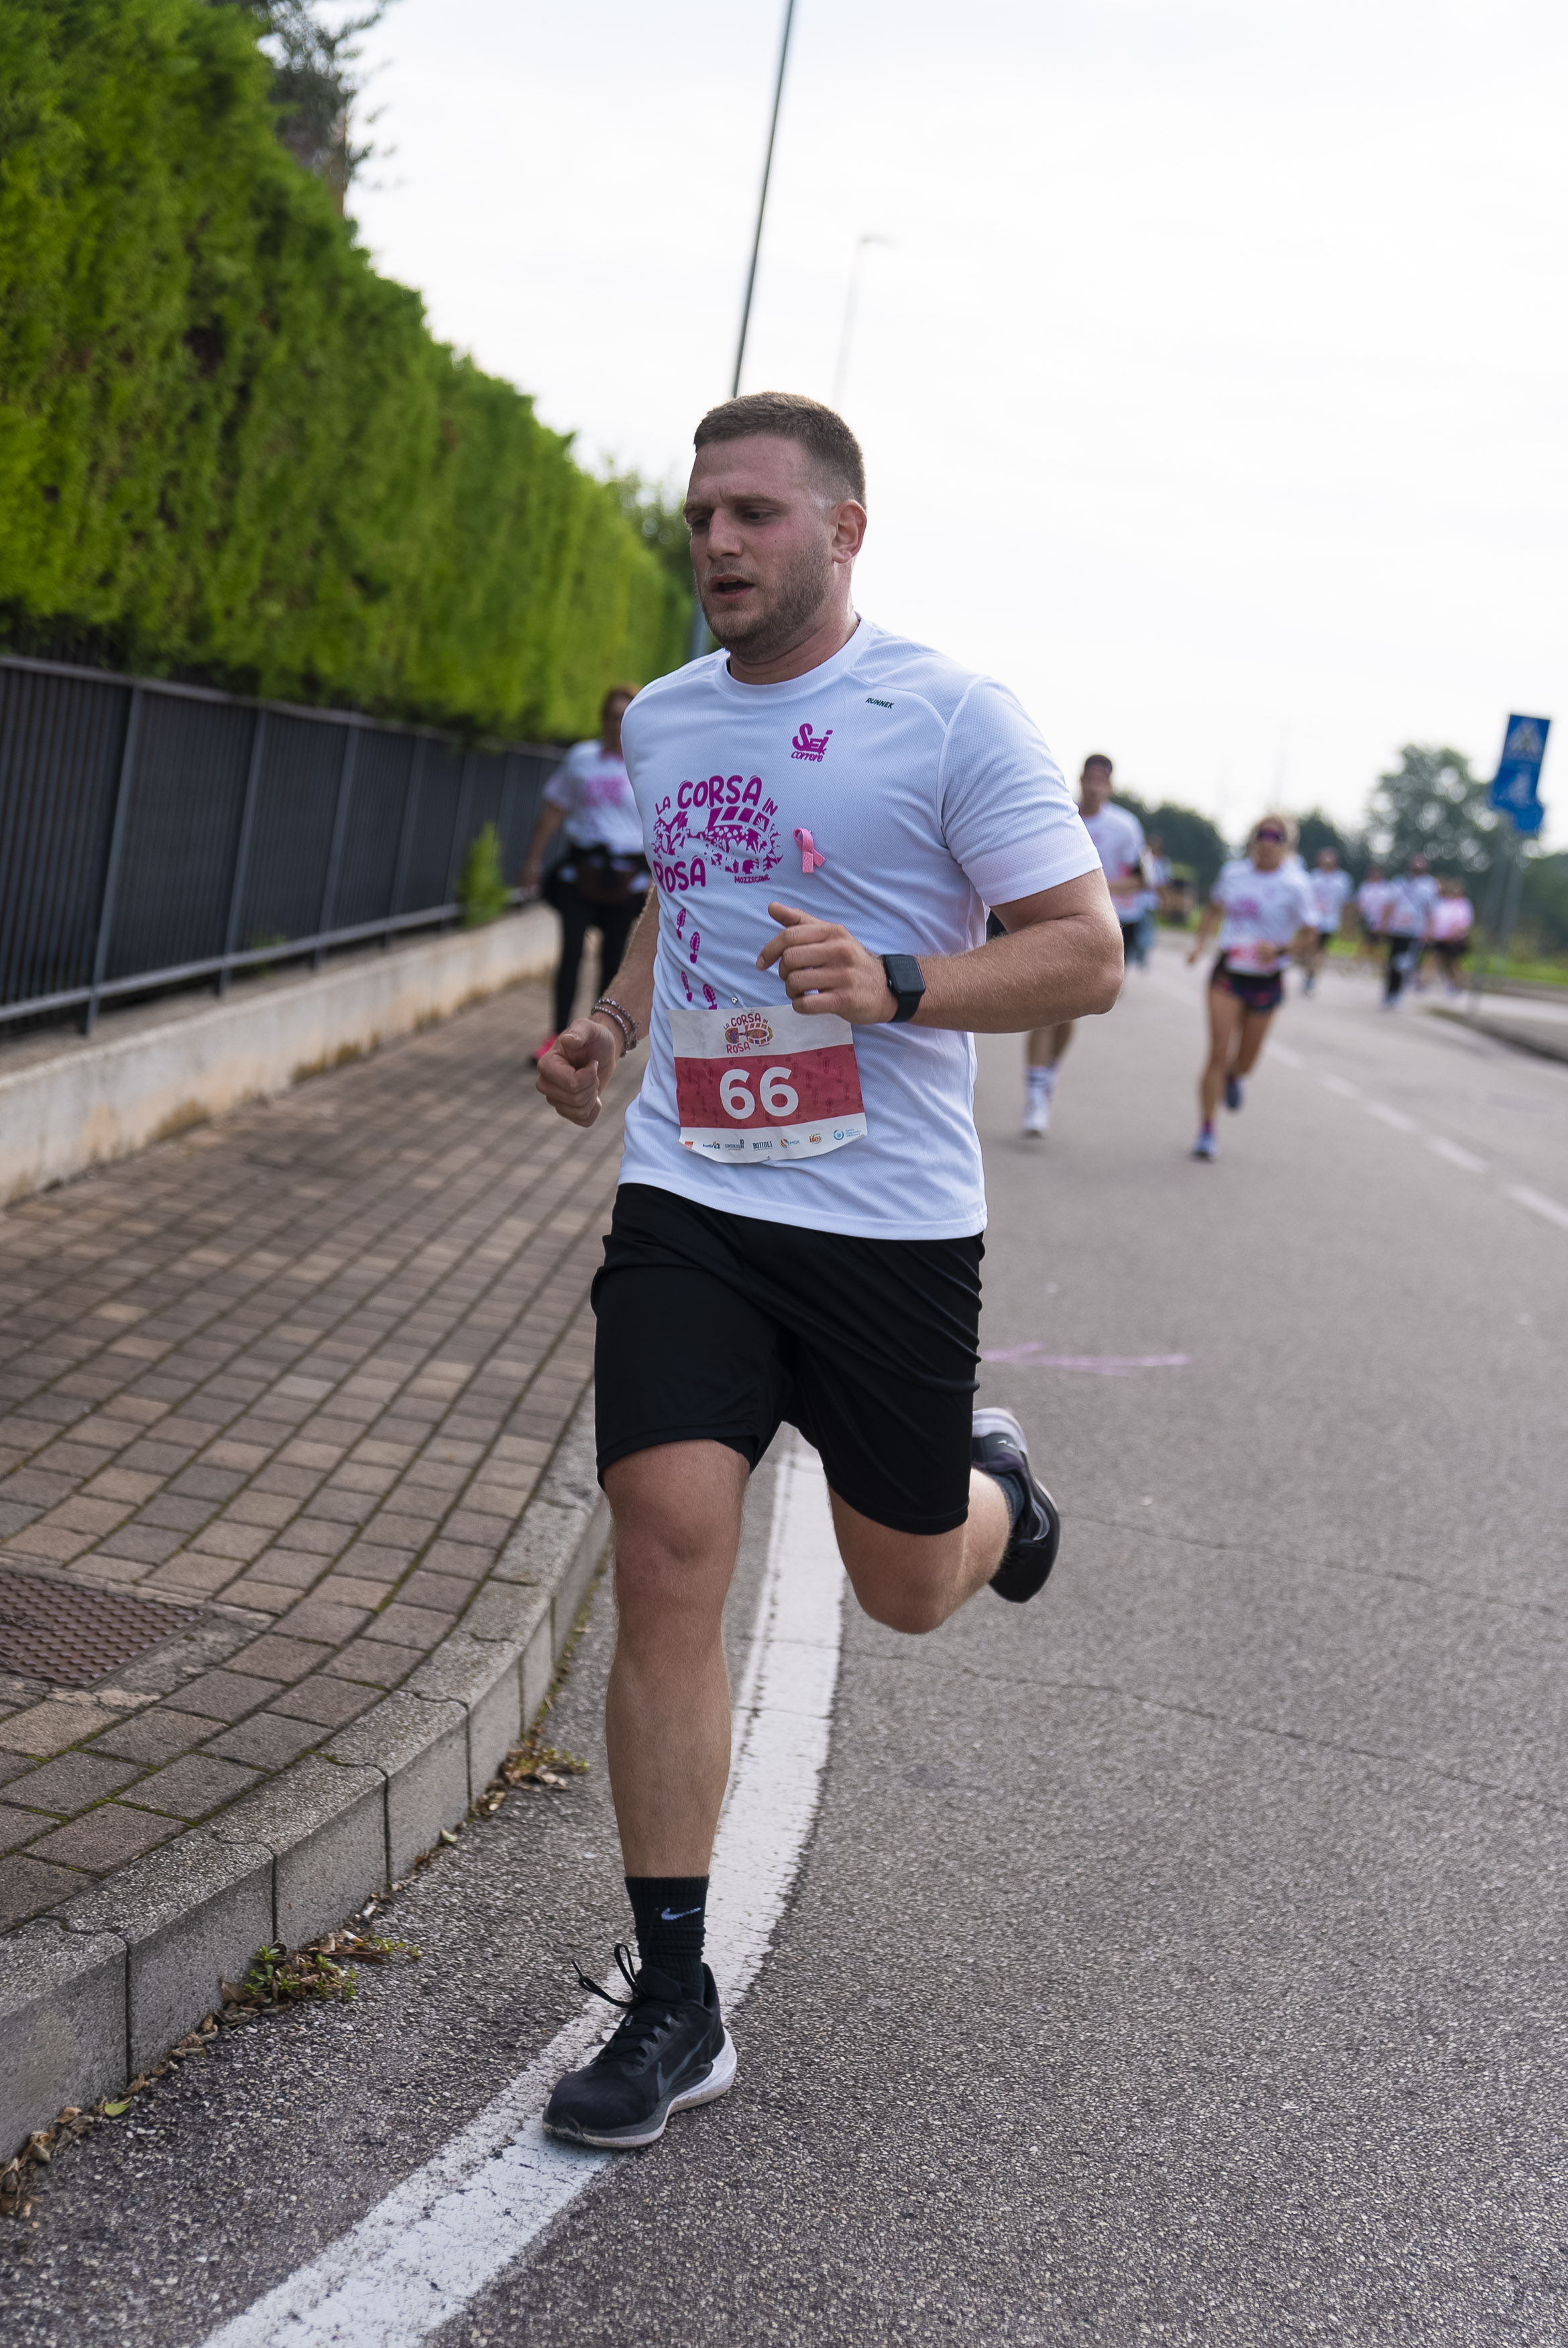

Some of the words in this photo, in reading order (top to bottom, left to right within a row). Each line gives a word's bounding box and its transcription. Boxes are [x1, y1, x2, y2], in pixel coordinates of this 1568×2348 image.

[655, 796, 671, 816] LA
[677, 775, 763, 809] CORSA
[762, 798, 778, 816] IN
[653, 857, 706, 893] ROSA
[731, 1012, 761, 1026] CORSA
[726, 1041, 750, 1054] ROSA
[720, 1067, 799, 1120] 66
[752, 1141, 773, 1149] BOTTOLI
